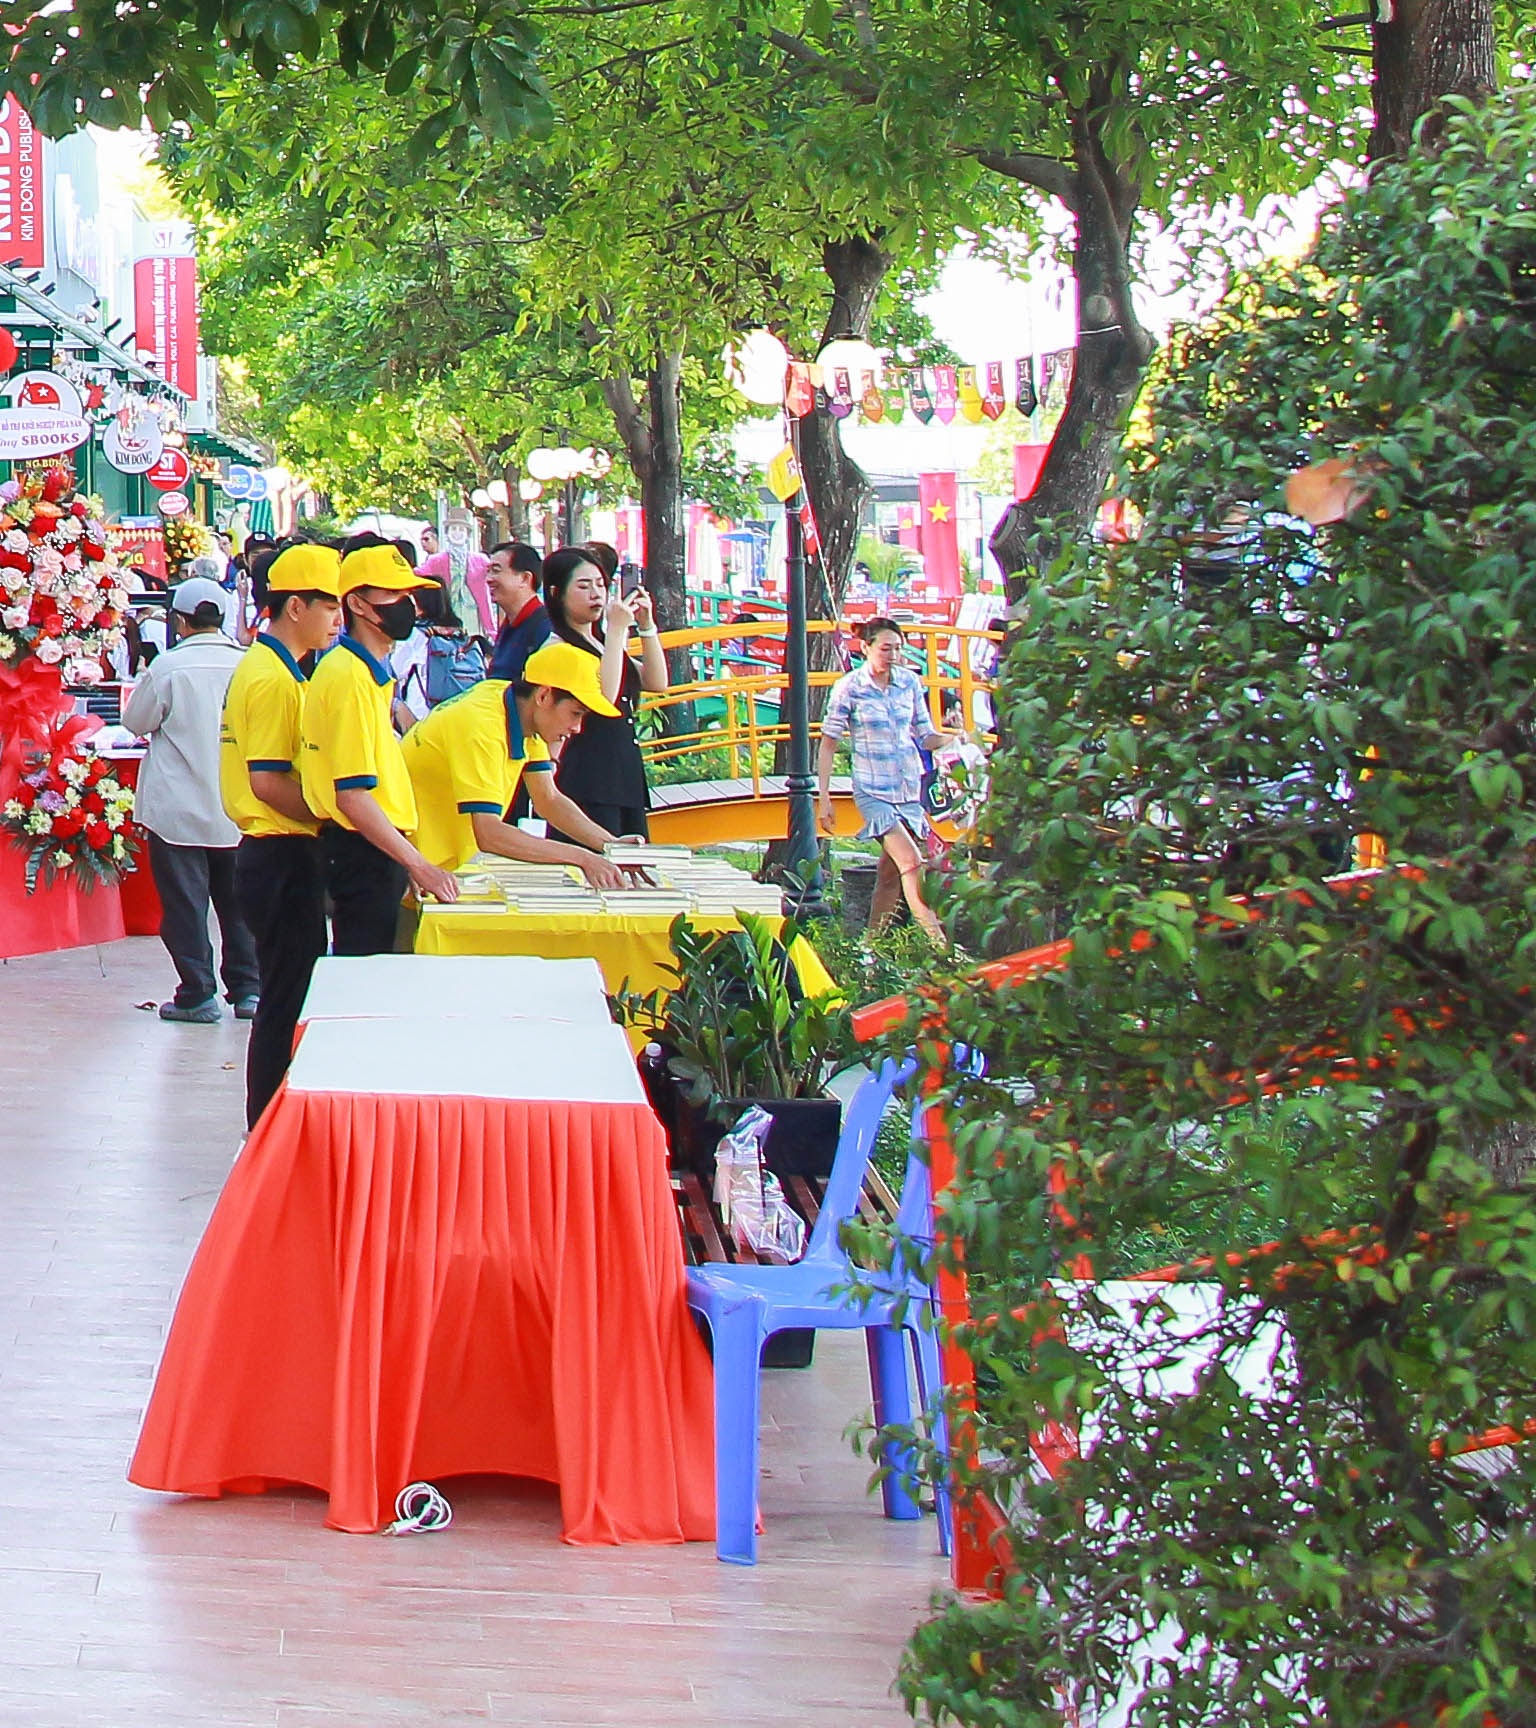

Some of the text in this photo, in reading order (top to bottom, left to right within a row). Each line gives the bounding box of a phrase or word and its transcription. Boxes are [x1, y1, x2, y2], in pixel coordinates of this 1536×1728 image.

[19, 109, 35, 241] KIM DONG PUBLISH
[20, 432, 81, 447] SBOOKS
[115, 451, 131, 465] KIM
[160, 453, 176, 470] ST
